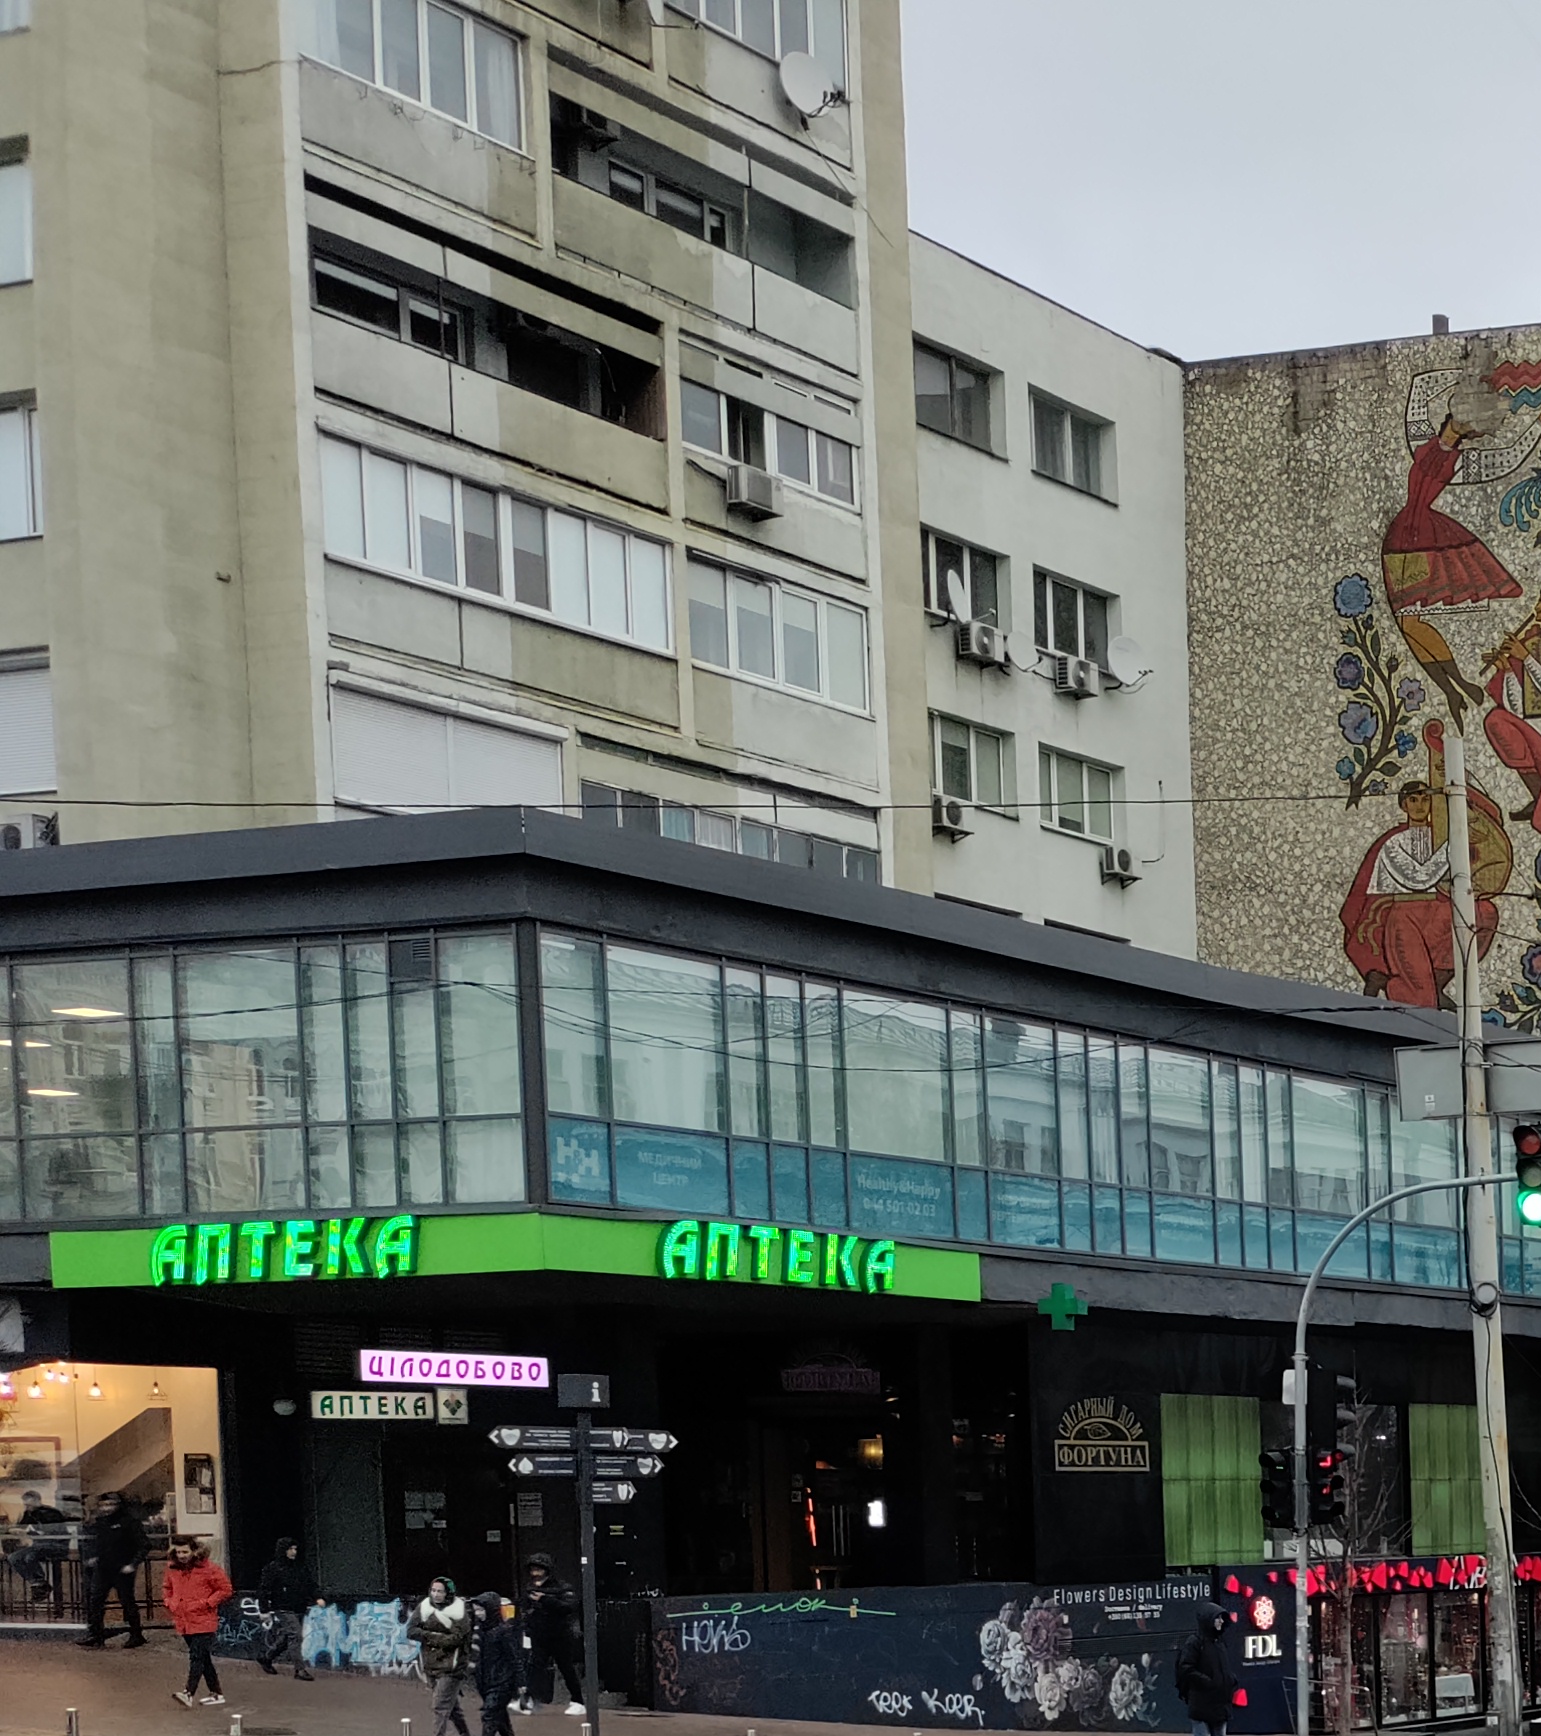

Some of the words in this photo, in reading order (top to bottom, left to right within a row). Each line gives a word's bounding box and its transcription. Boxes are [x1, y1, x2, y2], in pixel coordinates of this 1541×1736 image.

[652, 1172, 689, 1186] ЦЕНТР
[151, 1214, 414, 1287] АПТЕКА
[658, 1219, 896, 1294] АПТЕКА
[368, 1356, 542, 1381] ЦІЛОДОБОВО
[319, 1395, 427, 1418] АПТЕКА
[1058, 1395, 1115, 1438] СИГАРНЫЙ
[1117, 1404, 1144, 1440] ДОМ
[1059, 1446, 1146, 1466] ФОРТУНА
[1053, 1588, 1105, 1605] Flowers
[1109, 1584, 1153, 1602] Design
[1155, 1582, 1211, 1600] Lifestyle
[1244, 1634, 1282, 1659] FDL
